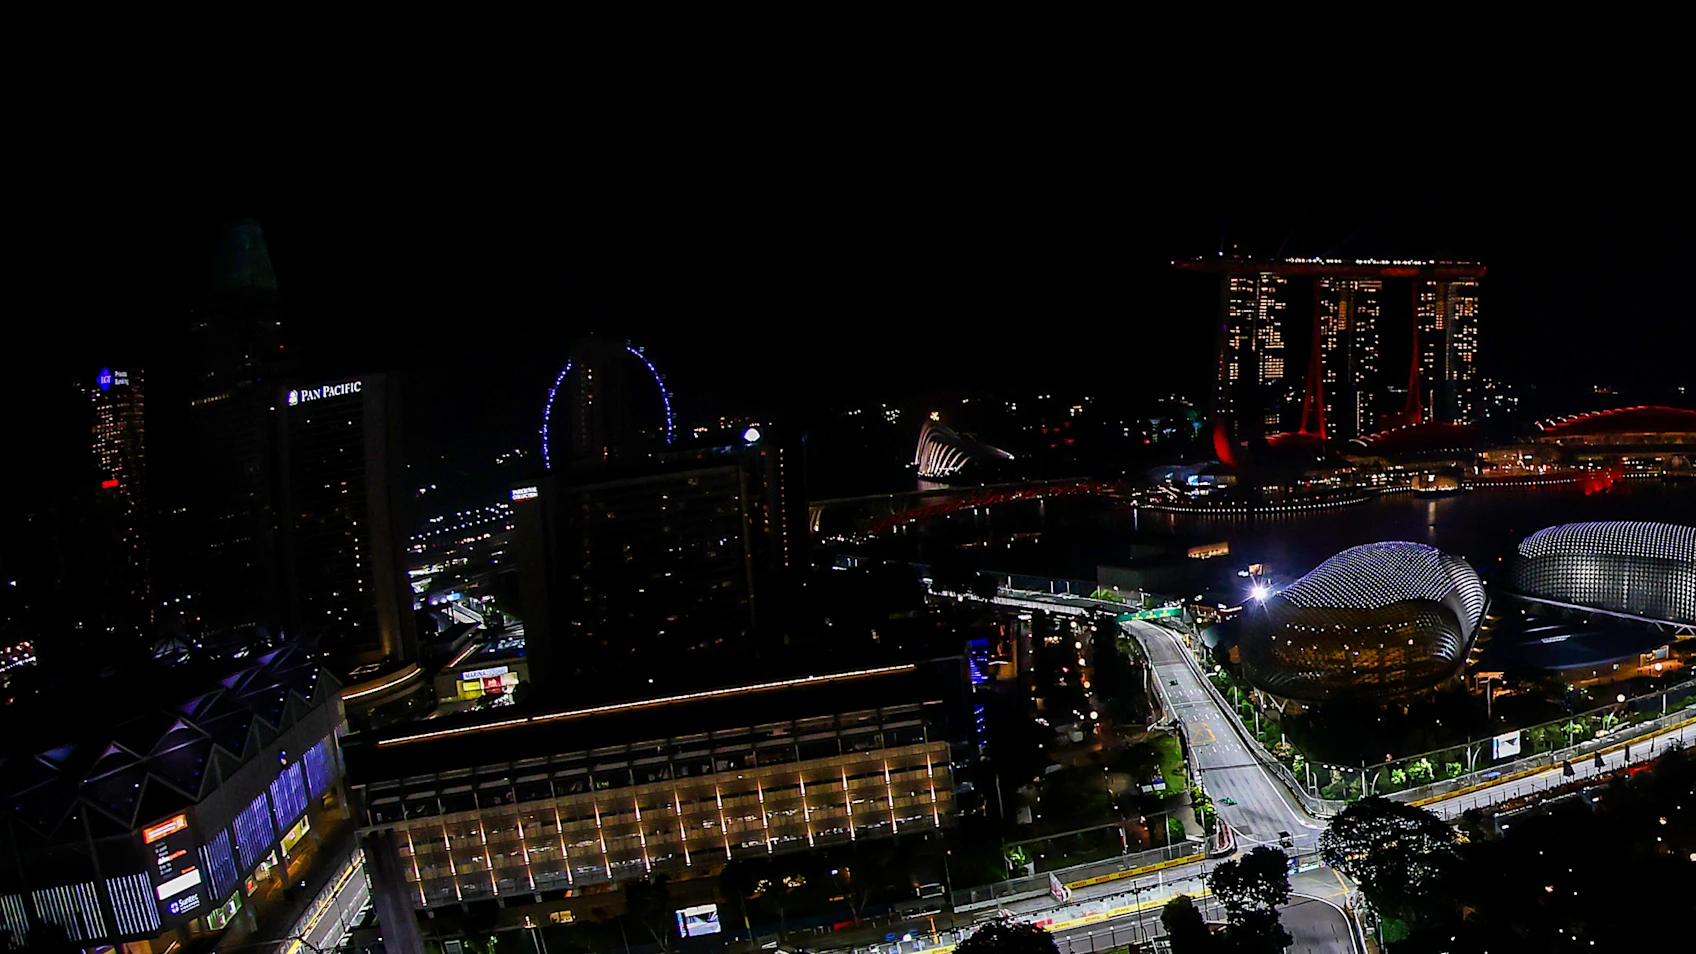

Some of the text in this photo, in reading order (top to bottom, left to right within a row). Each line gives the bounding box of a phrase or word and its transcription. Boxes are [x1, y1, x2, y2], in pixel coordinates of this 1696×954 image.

[301, 381, 362, 402] PAN PACIFIC
[178, 893, 199, 905] Suntec
